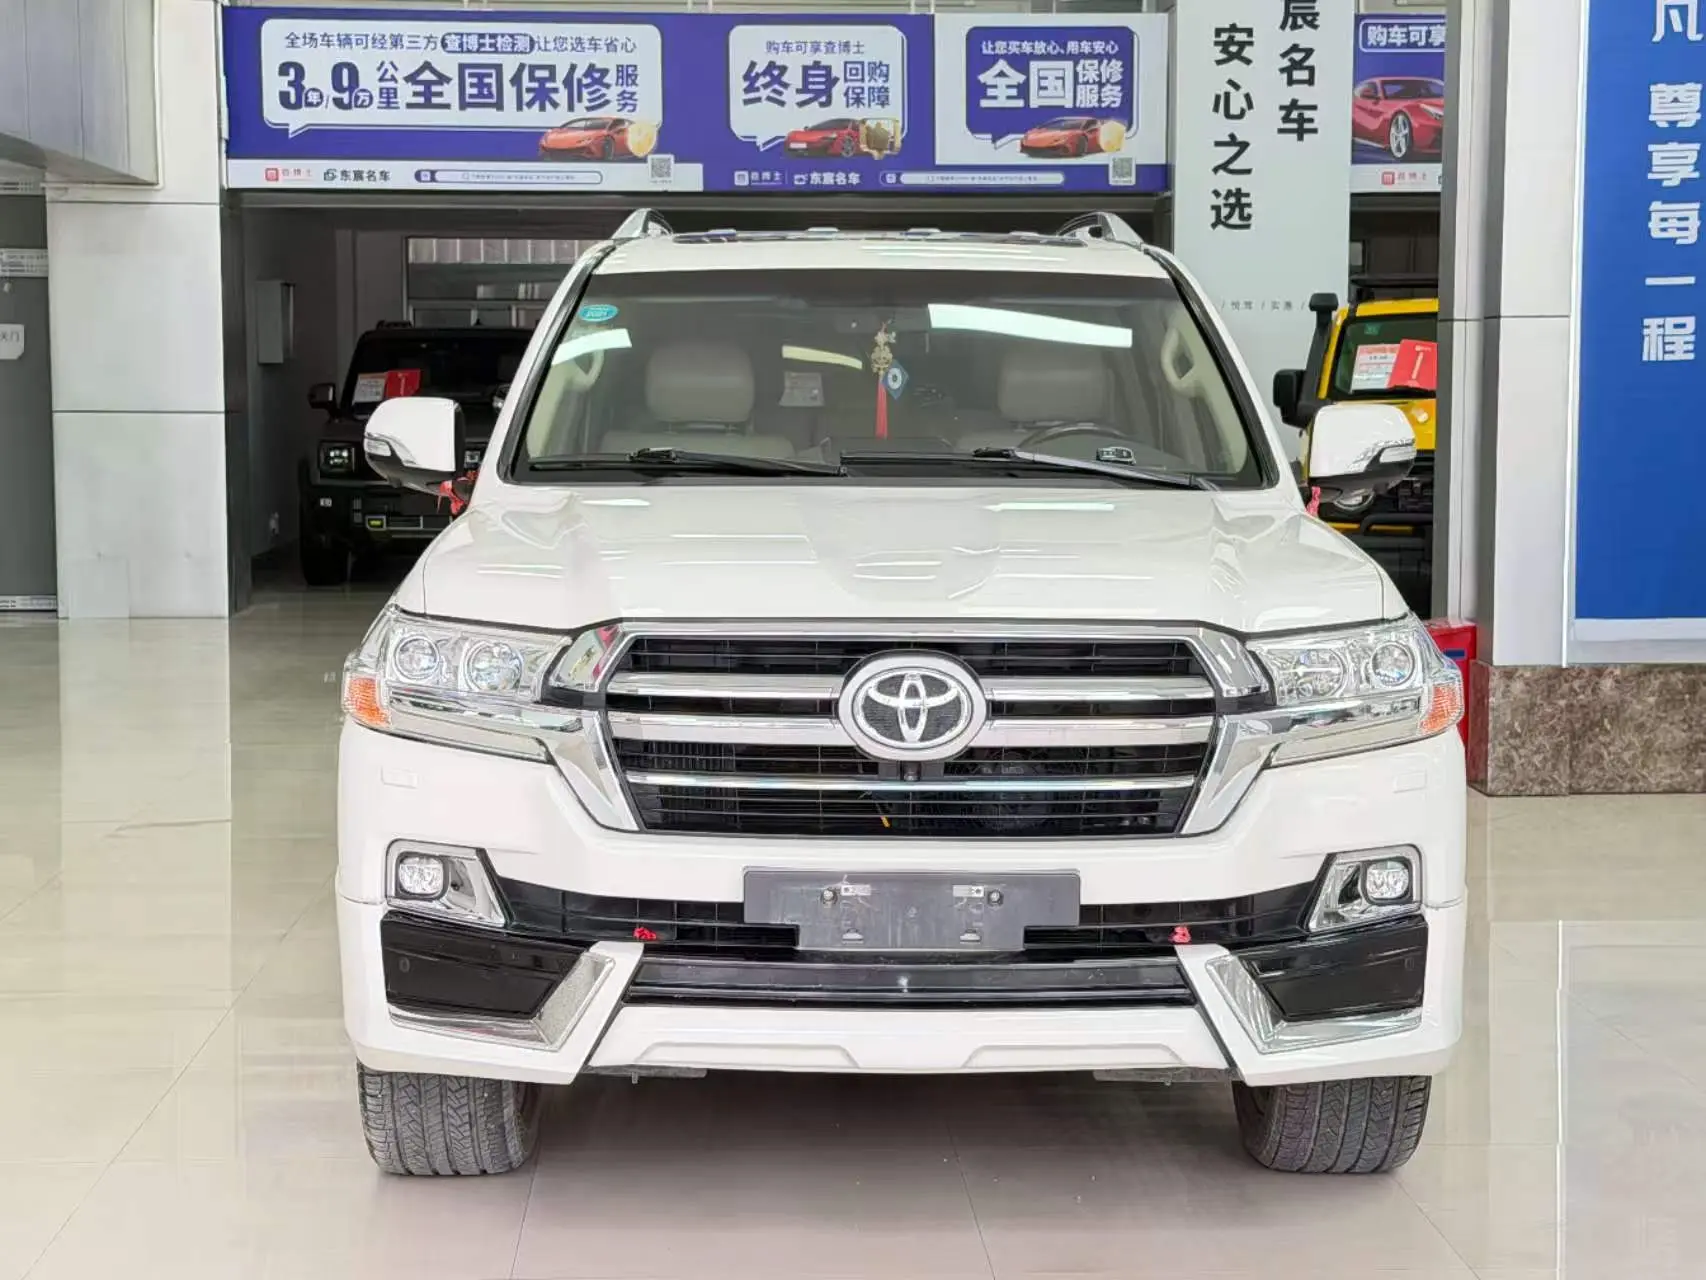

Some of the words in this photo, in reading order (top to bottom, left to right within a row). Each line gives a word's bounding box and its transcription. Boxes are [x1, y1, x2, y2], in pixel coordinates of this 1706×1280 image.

[1210, 22, 1254, 230] 安心之选
[1367, 25, 1446, 47] 购车可享
[1642, 82, 1702, 361] 尊享每一程
